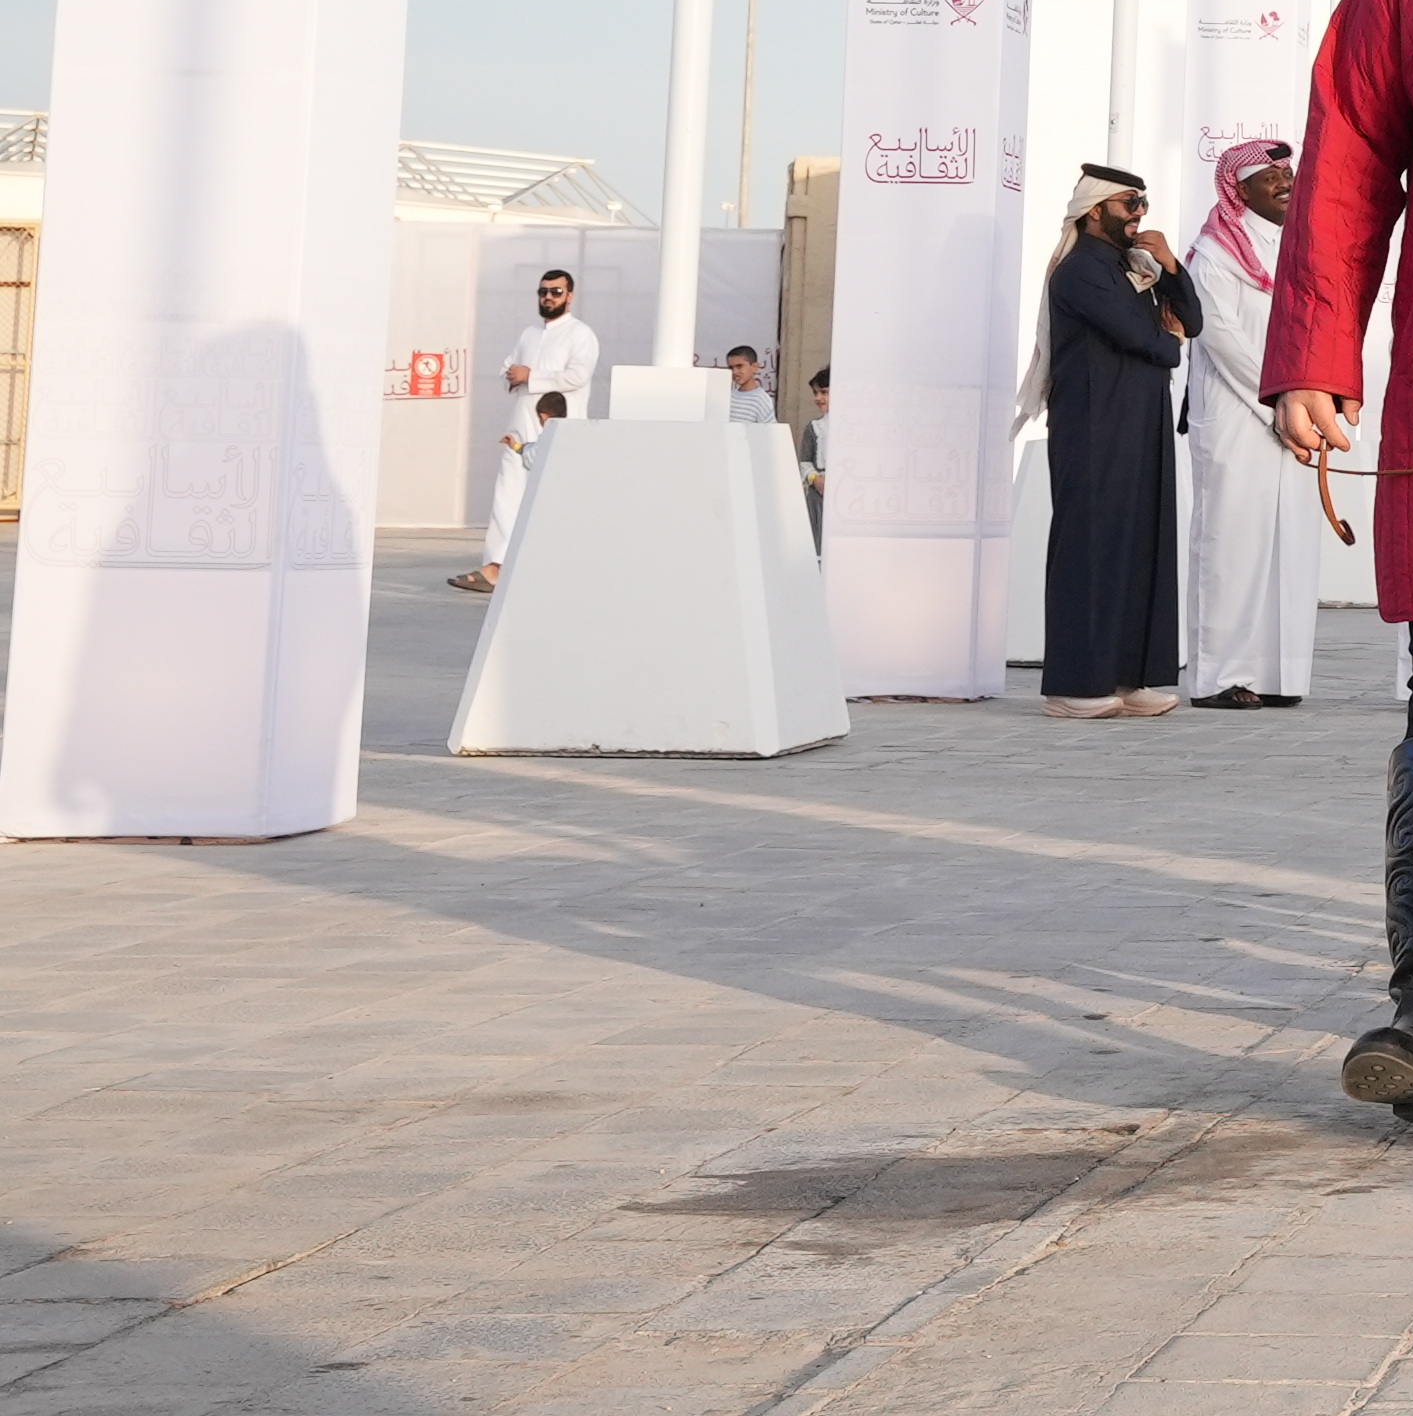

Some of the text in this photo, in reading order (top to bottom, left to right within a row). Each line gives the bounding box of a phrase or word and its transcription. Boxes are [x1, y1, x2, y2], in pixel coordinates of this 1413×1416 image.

[865, 7, 940, 18] Ministry of Culture
